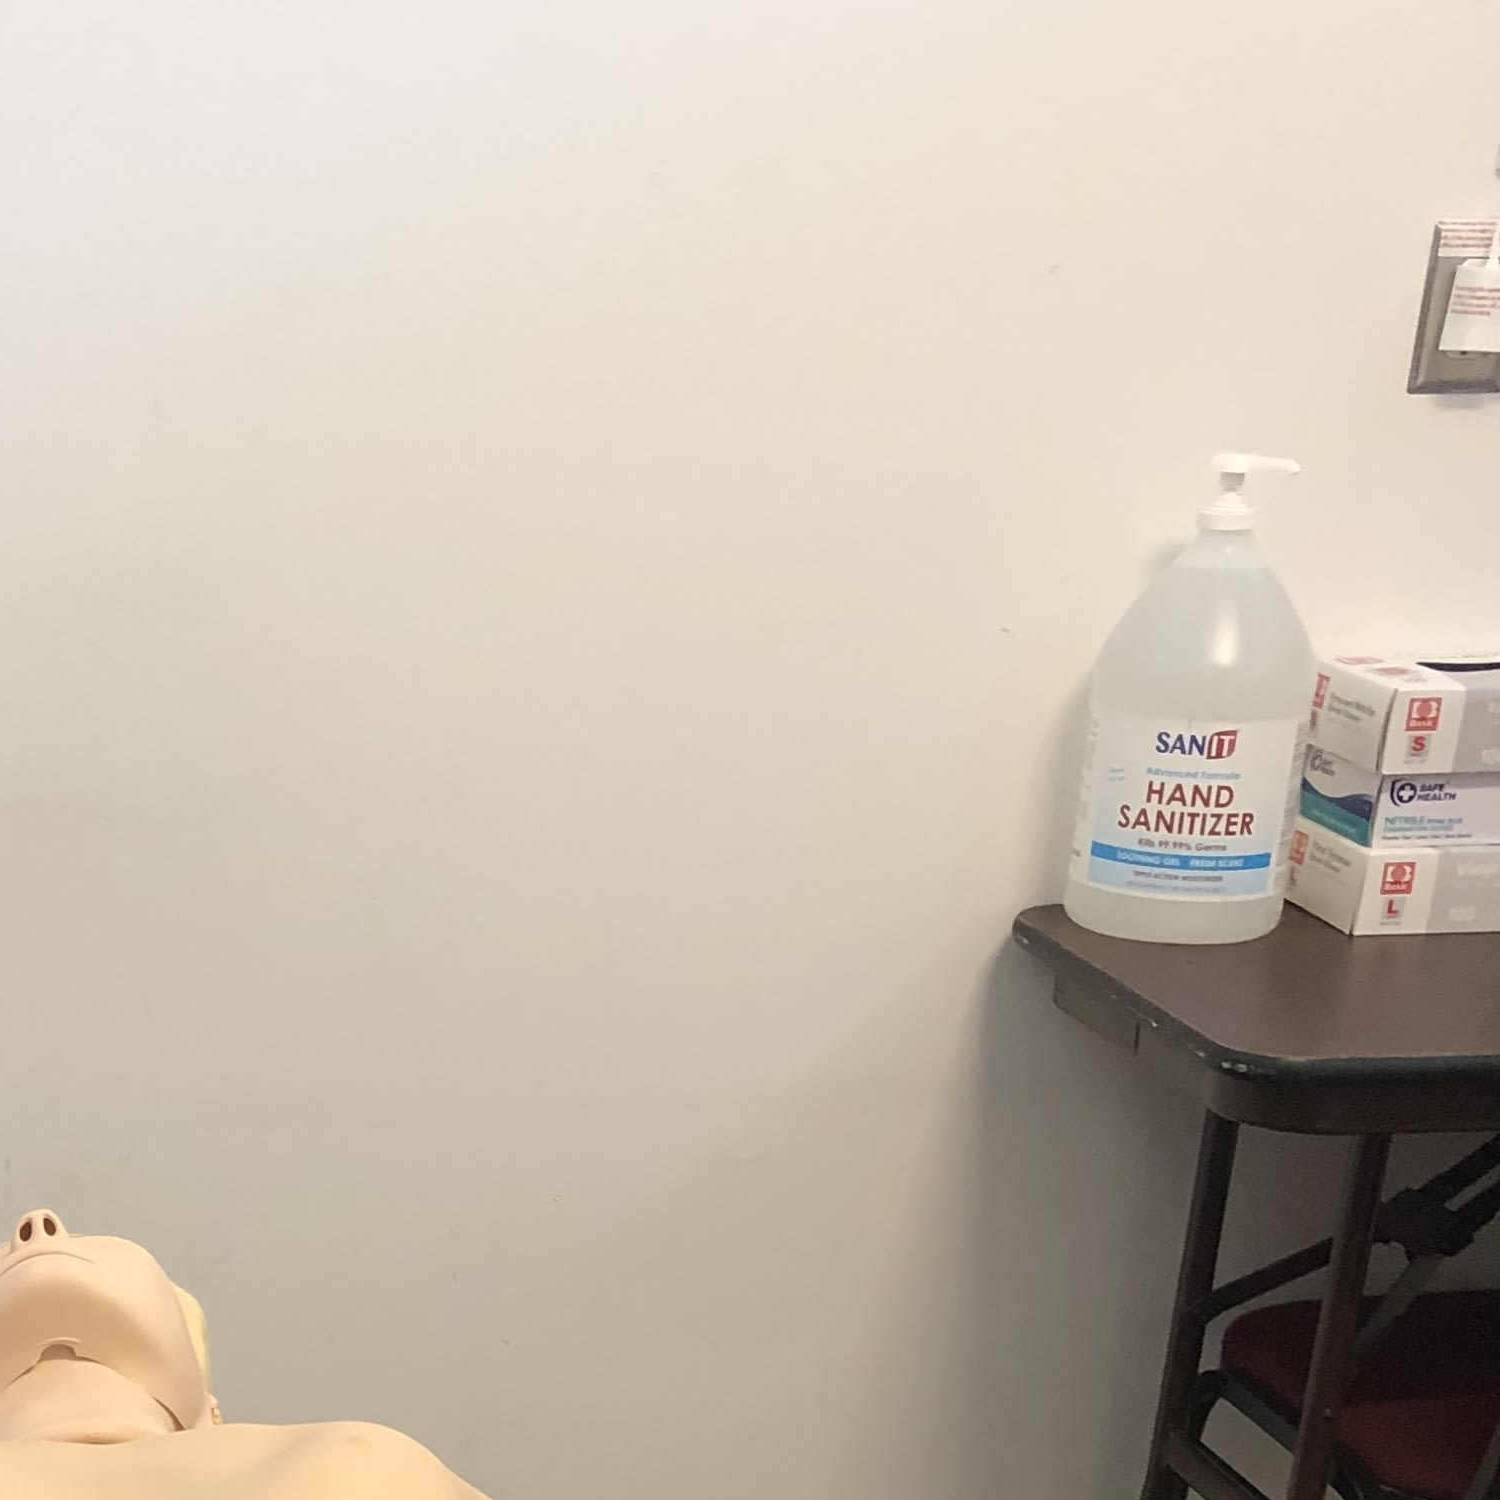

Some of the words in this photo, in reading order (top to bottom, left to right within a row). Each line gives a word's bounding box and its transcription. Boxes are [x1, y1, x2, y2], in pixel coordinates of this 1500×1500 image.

[1155, 730, 1237, 758] SANIT
[1411, 735, 1426, 752] S
[1147, 767, 1199, 780] Advanced
[1200, 770, 1241, 781] Formula
[1146, 780, 1234, 809] HAND
[1419, 783, 1447, 793] SAFE
[1417, 792, 1457, 802] HEALTH
[1117, 804, 1255, 836] SANITIZER
[1138, 837, 1155, 848] Kills
[1195, 842, 1227, 852] Germs
[1386, 899, 1399, 915] L
